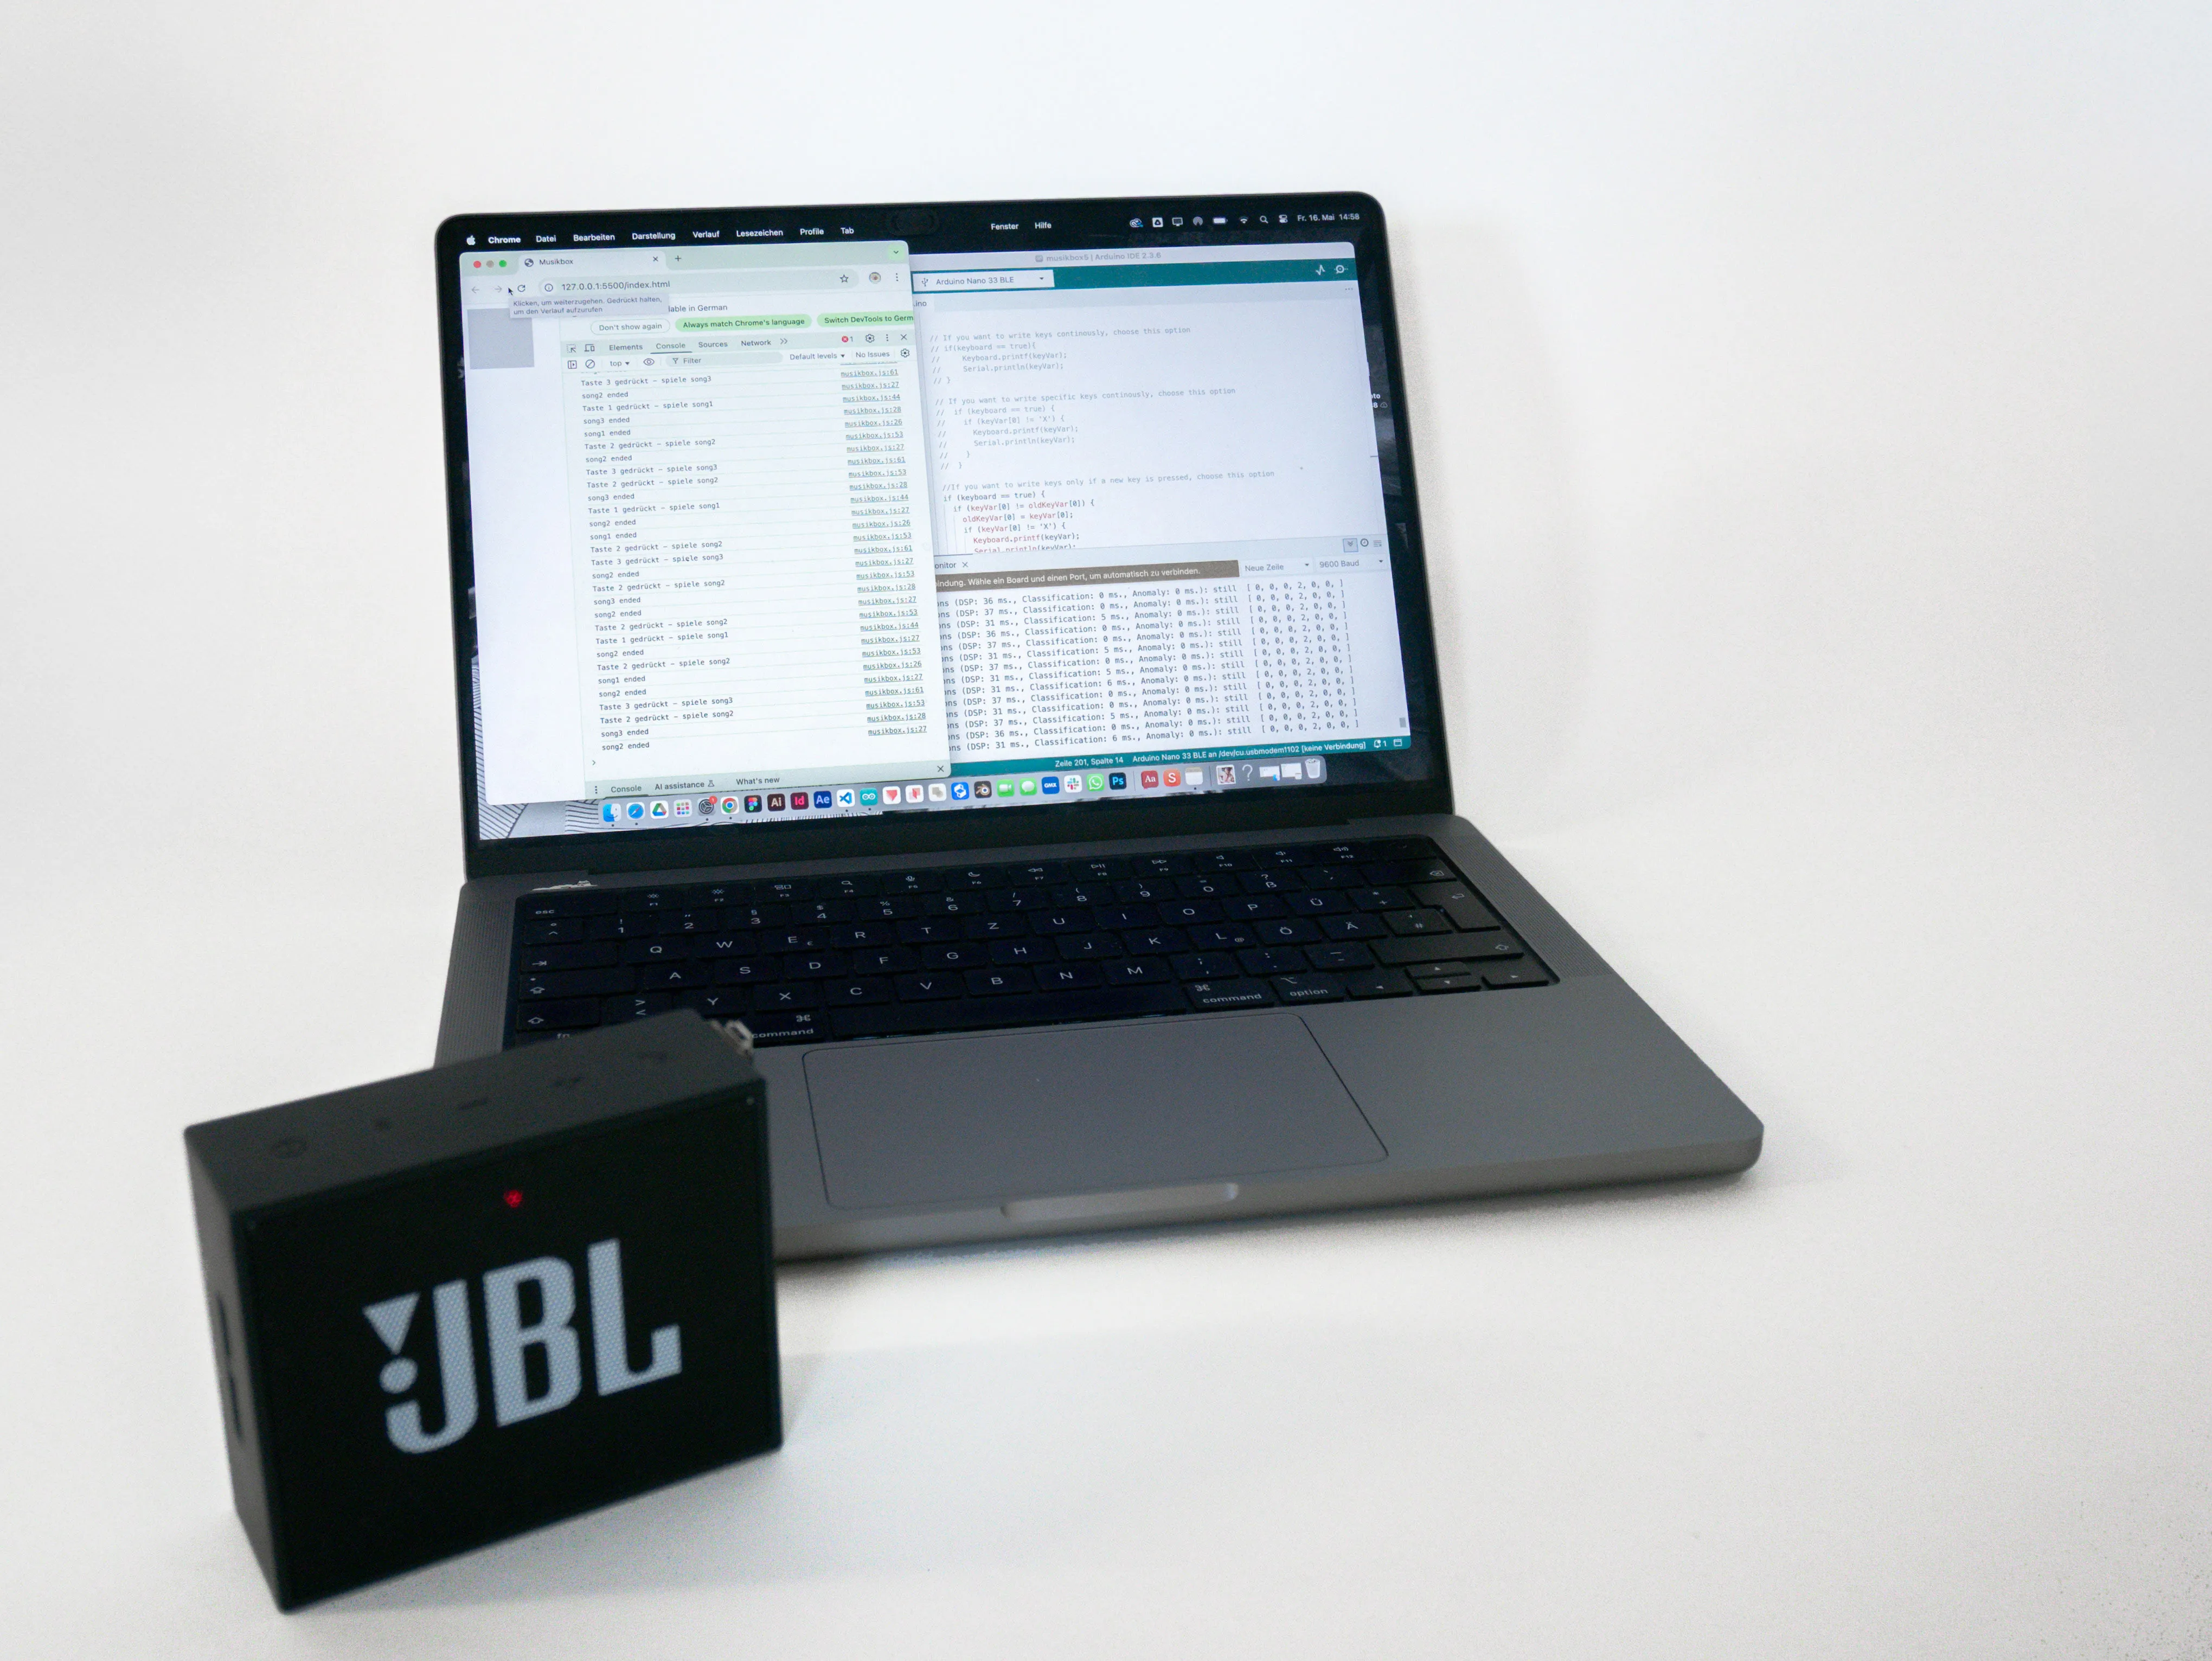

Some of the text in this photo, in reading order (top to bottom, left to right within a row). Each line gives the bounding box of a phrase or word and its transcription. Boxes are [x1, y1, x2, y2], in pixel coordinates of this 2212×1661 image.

[1322, 213, 1335, 221] Mai
[991, 222, 1019, 231] Fenster
[1035, 221, 1051, 230] Hilfe
[632, 232, 676, 240] Darstellung
[693, 230, 720, 238] Verlauf
[736, 229, 783, 237] Lesezeichen
[1047, 254, 1088, 262] musikbox5
[1095, 252, 1125, 261] Arduino
[1142, 251, 1162, 259] 2.3.6
[936, 277, 964, 285] Arduino
[1000, 275, 1014, 283] BLE
[561, 281, 670, 291] 127.0.0.1:5500/index.html
[554, 298, 604, 306] weiterzugehen.
[772, 318, 805, 326] language
[642, 323, 662, 331] again
[841, 369, 899, 377] musikbox.js:61
[615, 377, 649, 386] gedrückt
[842, 381, 899, 390] musikbox.js:27
[581, 392, 603, 400] song2
[963, 513, 1015, 523] oldKeyVar[0]
[1030, 511, 1073, 520] keyVar[0];
[973, 533, 1080, 544] Keyboard.printf(keyVar);
[1245, 563, 1284, 572] Neue Zeile
[1341, 559, 1360, 567] Baud
[968, 578, 991, 586] Wähle
[1007, 575, 1029, 584] Board
[1070, 573, 1087, 581] Port,
[1103, 569, 1149, 579] automatisch
[1161, 567, 1201, 576] verbinden.
[867, 712, 926, 723] musikbox.js:28
[601, 728, 649, 739] song3 ended
[868, 725, 927, 736] musikbox.js:27
[967, 742, 990, 751] (DSP:
[1035, 736, 1107, 747] Classification:
[1146, 731, 1183, 740] Anomaly:
[1228, 727, 1252, 735] still
[602, 741, 650, 752] song2 ended
[1133, 754, 1159, 763] Arduino
[1219, 746, 1299, 758] /dev/cu.usbmodem1102
[1301, 744, 1323, 753] [keine
[1325, 742, 1366, 751] Verbindung]
[1091, 758, 1112, 767] Spalte
[1112, 777, 1124, 785] Ps
[1168, 773, 1176, 783] S
[611, 785, 642, 793] Console
[655, 780, 704, 791] AI assistance
[771, 797, 781, 807] Ai
[794, 795, 804, 805] Id
[816, 794, 829, 805] Ae
[988, 922, 999, 931] Z
[650, 946, 663, 954] Q
[991, 977, 1003, 985] B
[920, 982, 932, 990] V
[850, 987, 863, 996] C
[1290, 987, 1329, 998] option
[779, 992, 792, 1001] X
[1203, 992, 1262, 1004] command
[752, 1029, 814, 1038] command
[384, 1237, 683, 1454] JBL
